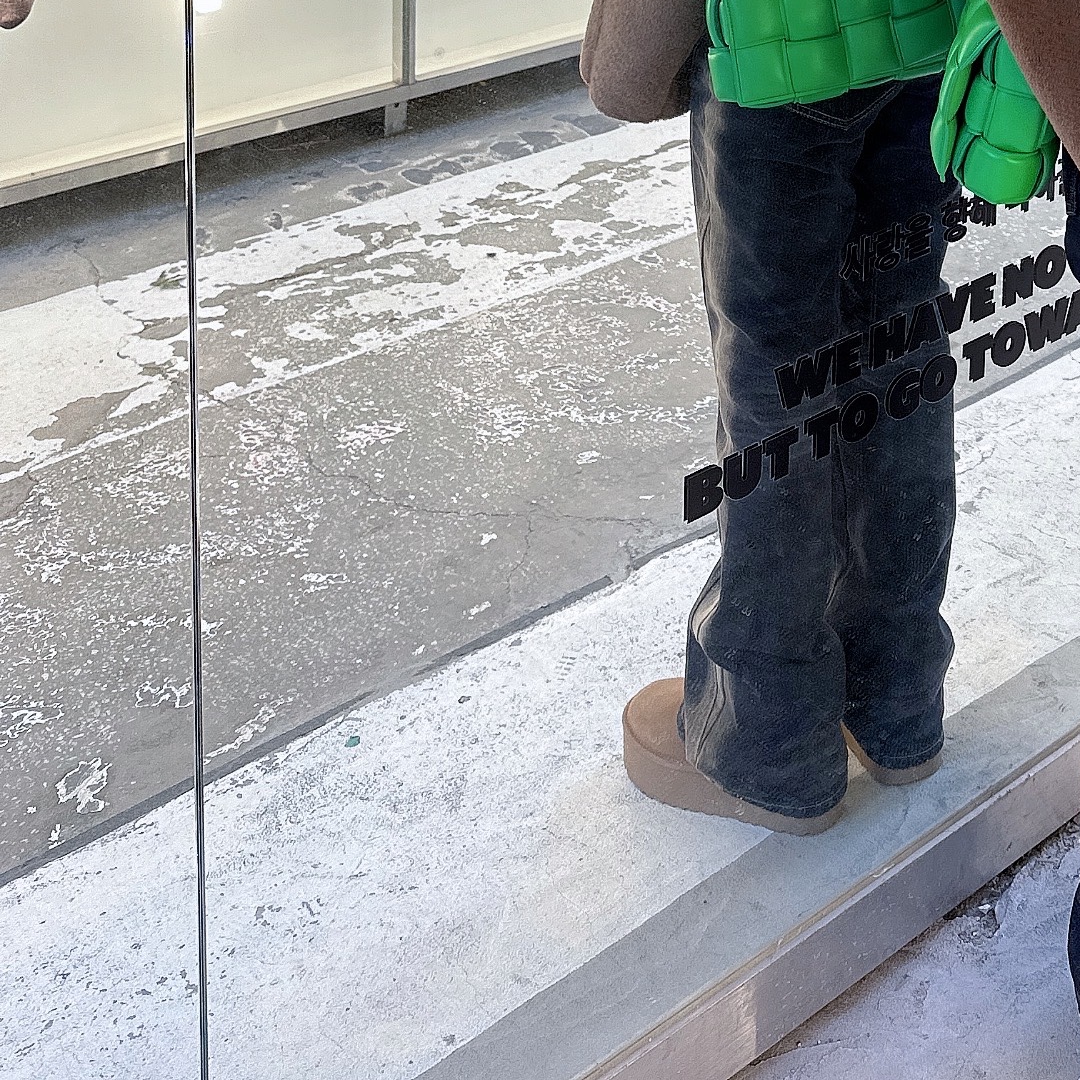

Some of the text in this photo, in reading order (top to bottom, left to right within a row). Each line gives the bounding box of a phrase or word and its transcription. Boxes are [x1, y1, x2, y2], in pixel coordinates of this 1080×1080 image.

[774, 245, 1067, 410] WE HAVE NO
[839, 212, 934, 282] 사랑을
[683, 428, 799, 524] BUT
[805, 392, 879, 461] TO
[886, 355, 958, 420] GO
